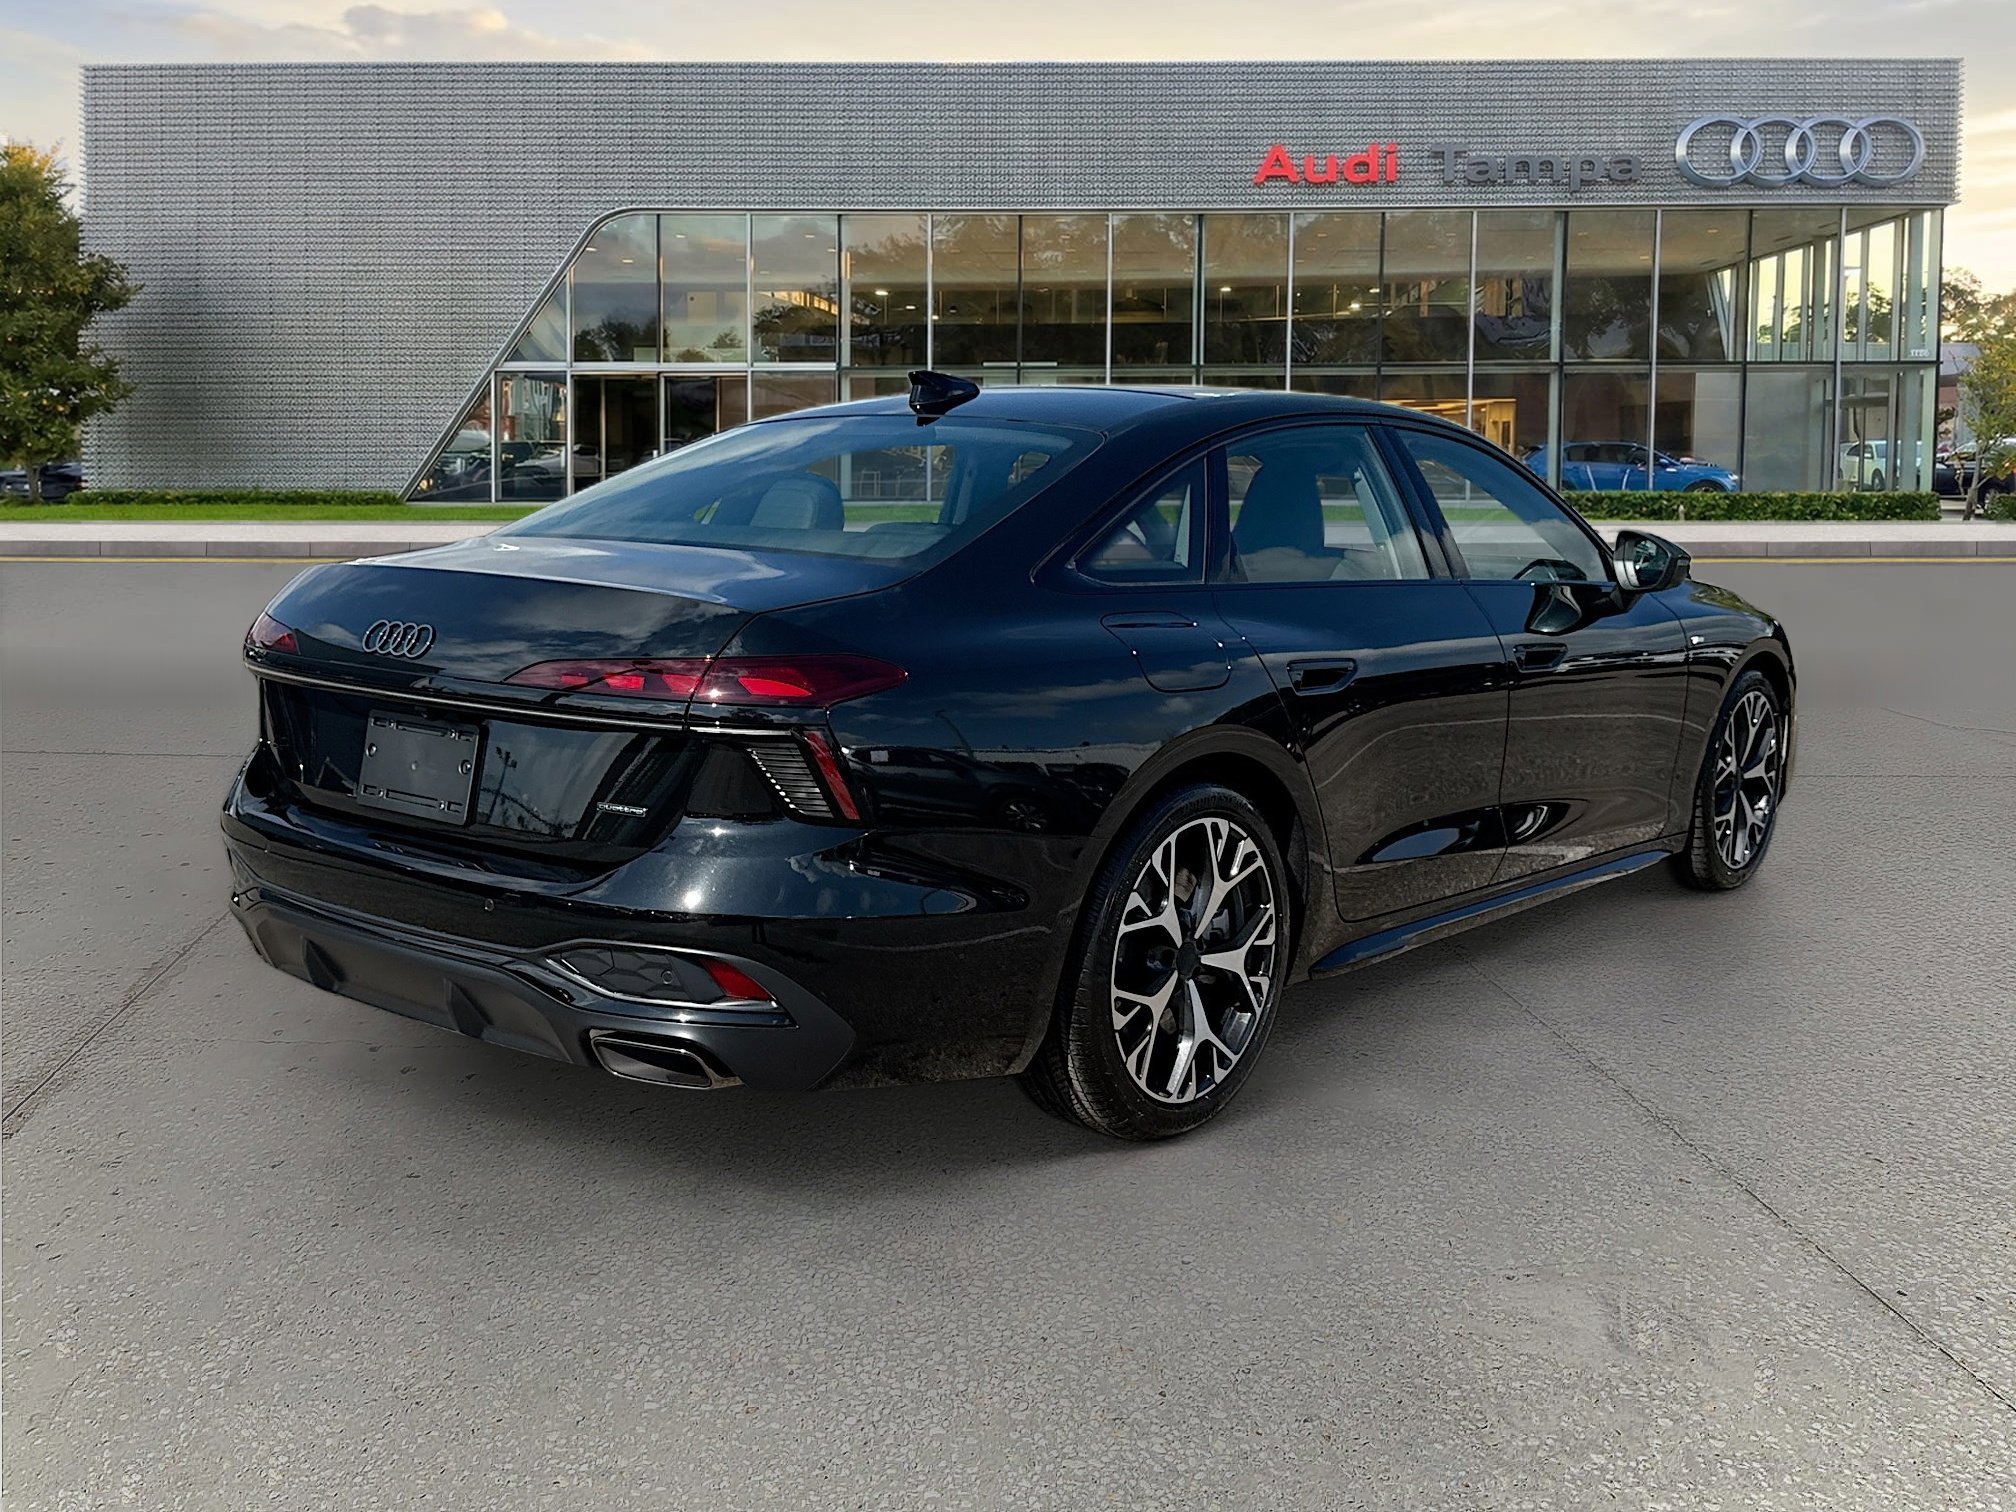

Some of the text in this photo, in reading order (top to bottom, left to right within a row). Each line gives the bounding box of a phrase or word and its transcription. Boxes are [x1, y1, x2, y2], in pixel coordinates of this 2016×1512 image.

[1254, 143, 1642, 193] Audi Tampa
[598, 803, 646, 816] quattro
